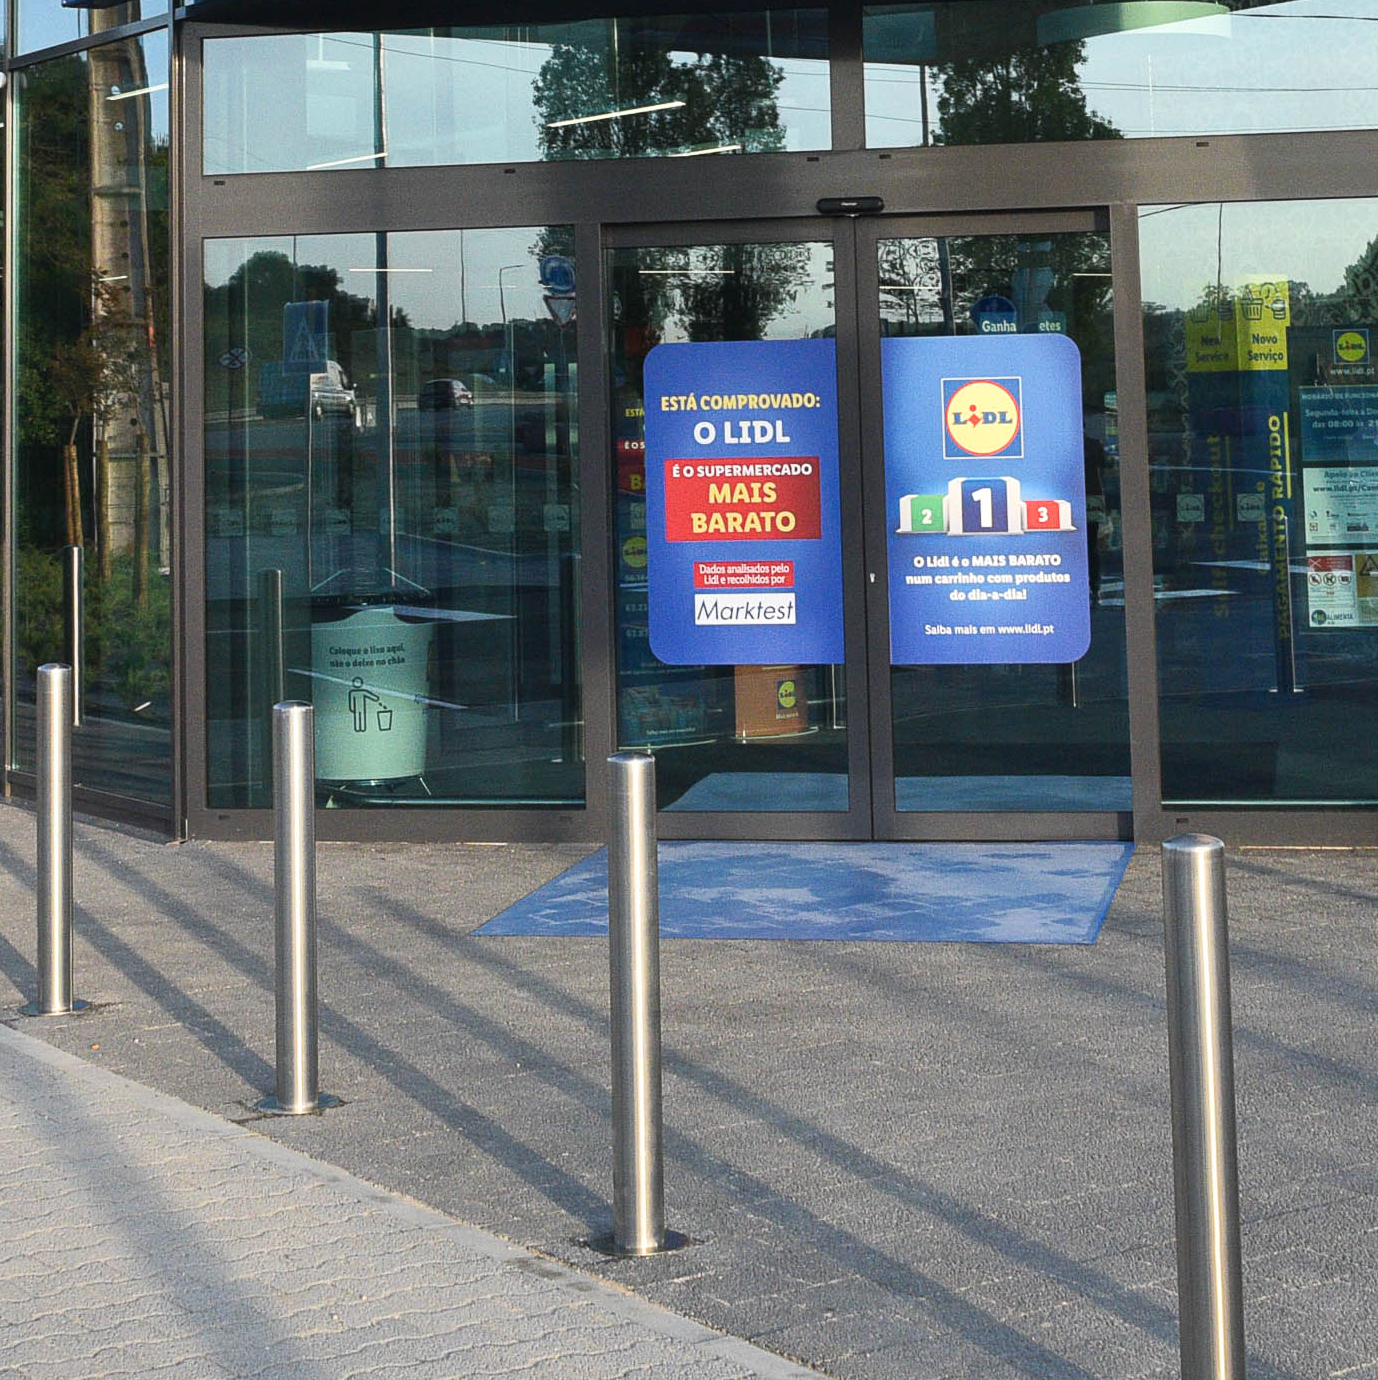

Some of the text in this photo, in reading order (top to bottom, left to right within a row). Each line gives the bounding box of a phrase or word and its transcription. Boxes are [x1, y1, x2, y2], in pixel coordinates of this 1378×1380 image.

[982, 320, 1017, 332] Ganha
[1251, 333, 1278, 345] Novo
[1247, 348, 1284, 364] Serviço
[661, 392, 821, 411] ESTÁ COMPROVADO:
[693, 420, 791, 445] O LIDL
[672, 463, 813, 478] É O SUPERMERCADO
[708, 482, 777, 504] MAIS
[921, 488, 1049, 528] 2 1 3
[691, 511, 796, 533] BARATO
[913, 554, 1061, 568] O Lidl é o MAIS BARATO
[699, 563, 790, 575] Dados analisados pelo
[704, 574, 719, 585] Lidl
[727, 574, 769, 584] recolhidos
[771, 576, 786, 586] por
[906, 572, 1071, 585] num carrinho com produtos
[950, 588, 1027, 601] do dia-a-dia!
[697, 599, 793, 621] Marktest
[925, 624, 1054, 635] Saiba mais em www.lidl.pt
[329, 645, 361, 656] Coloque
[363, 647, 369, 655] o
[370, 644, 385, 654] lixo
[345, 659, 351, 667] o
[376, 658, 386, 666] no
